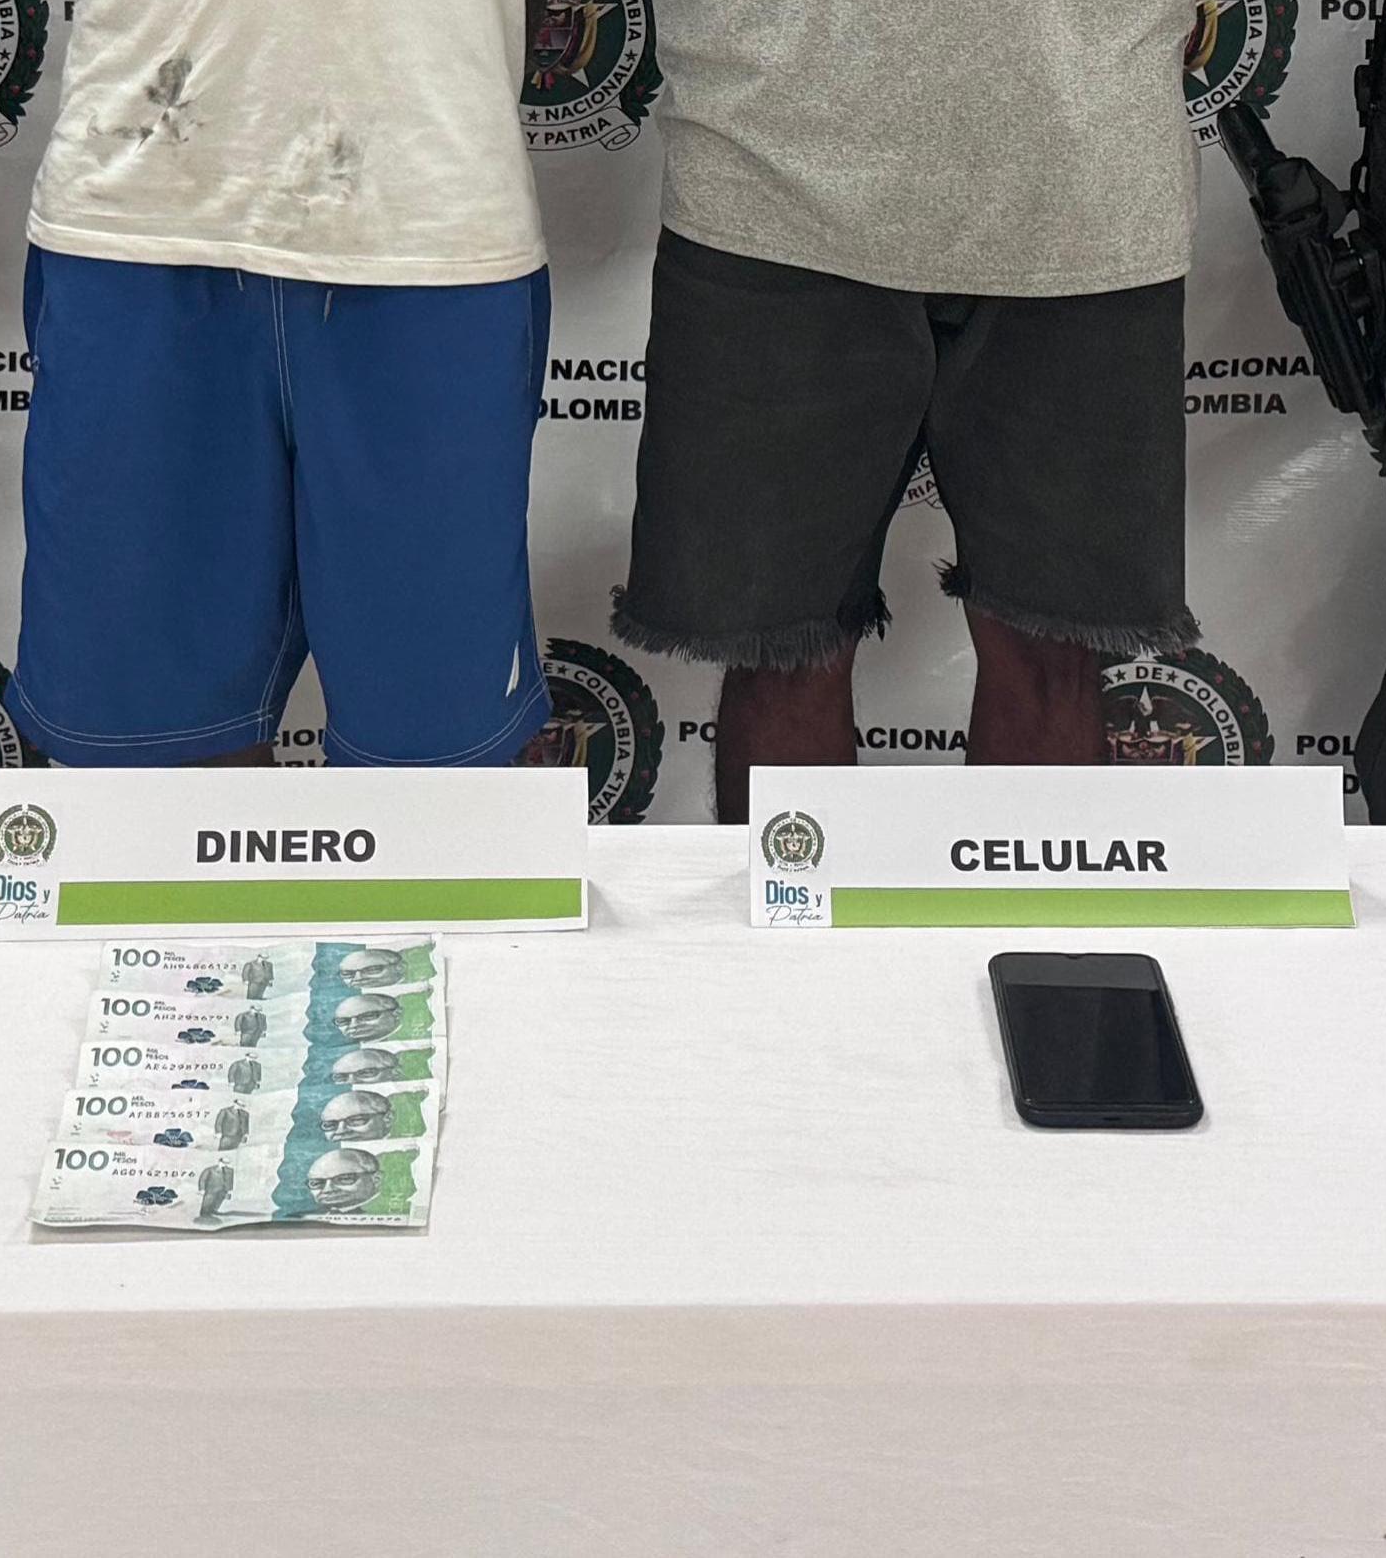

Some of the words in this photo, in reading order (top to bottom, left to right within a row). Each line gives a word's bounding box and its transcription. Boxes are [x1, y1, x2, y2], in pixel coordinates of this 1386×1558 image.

[545, 65, 632, 120] NACIONAL
[545, 118, 610, 144] PATRIA
[575, 671, 630, 760] COLOMBIA
[197, 829, 375, 862] DINERO
[951, 840, 1167, 871] CELULAR
[43, 890, 51, 903] y
[765, 880, 809, 905] Dios
[815, 894, 823, 907] y
[766, 905, 823, 926] Patria
[112, 948, 161, 967] 100
[101, 998, 151, 1016] 100
[91, 1047, 142, 1067] 100
[76, 1096, 128, 1116] 100
[54, 1148, 109, 1171] 100
